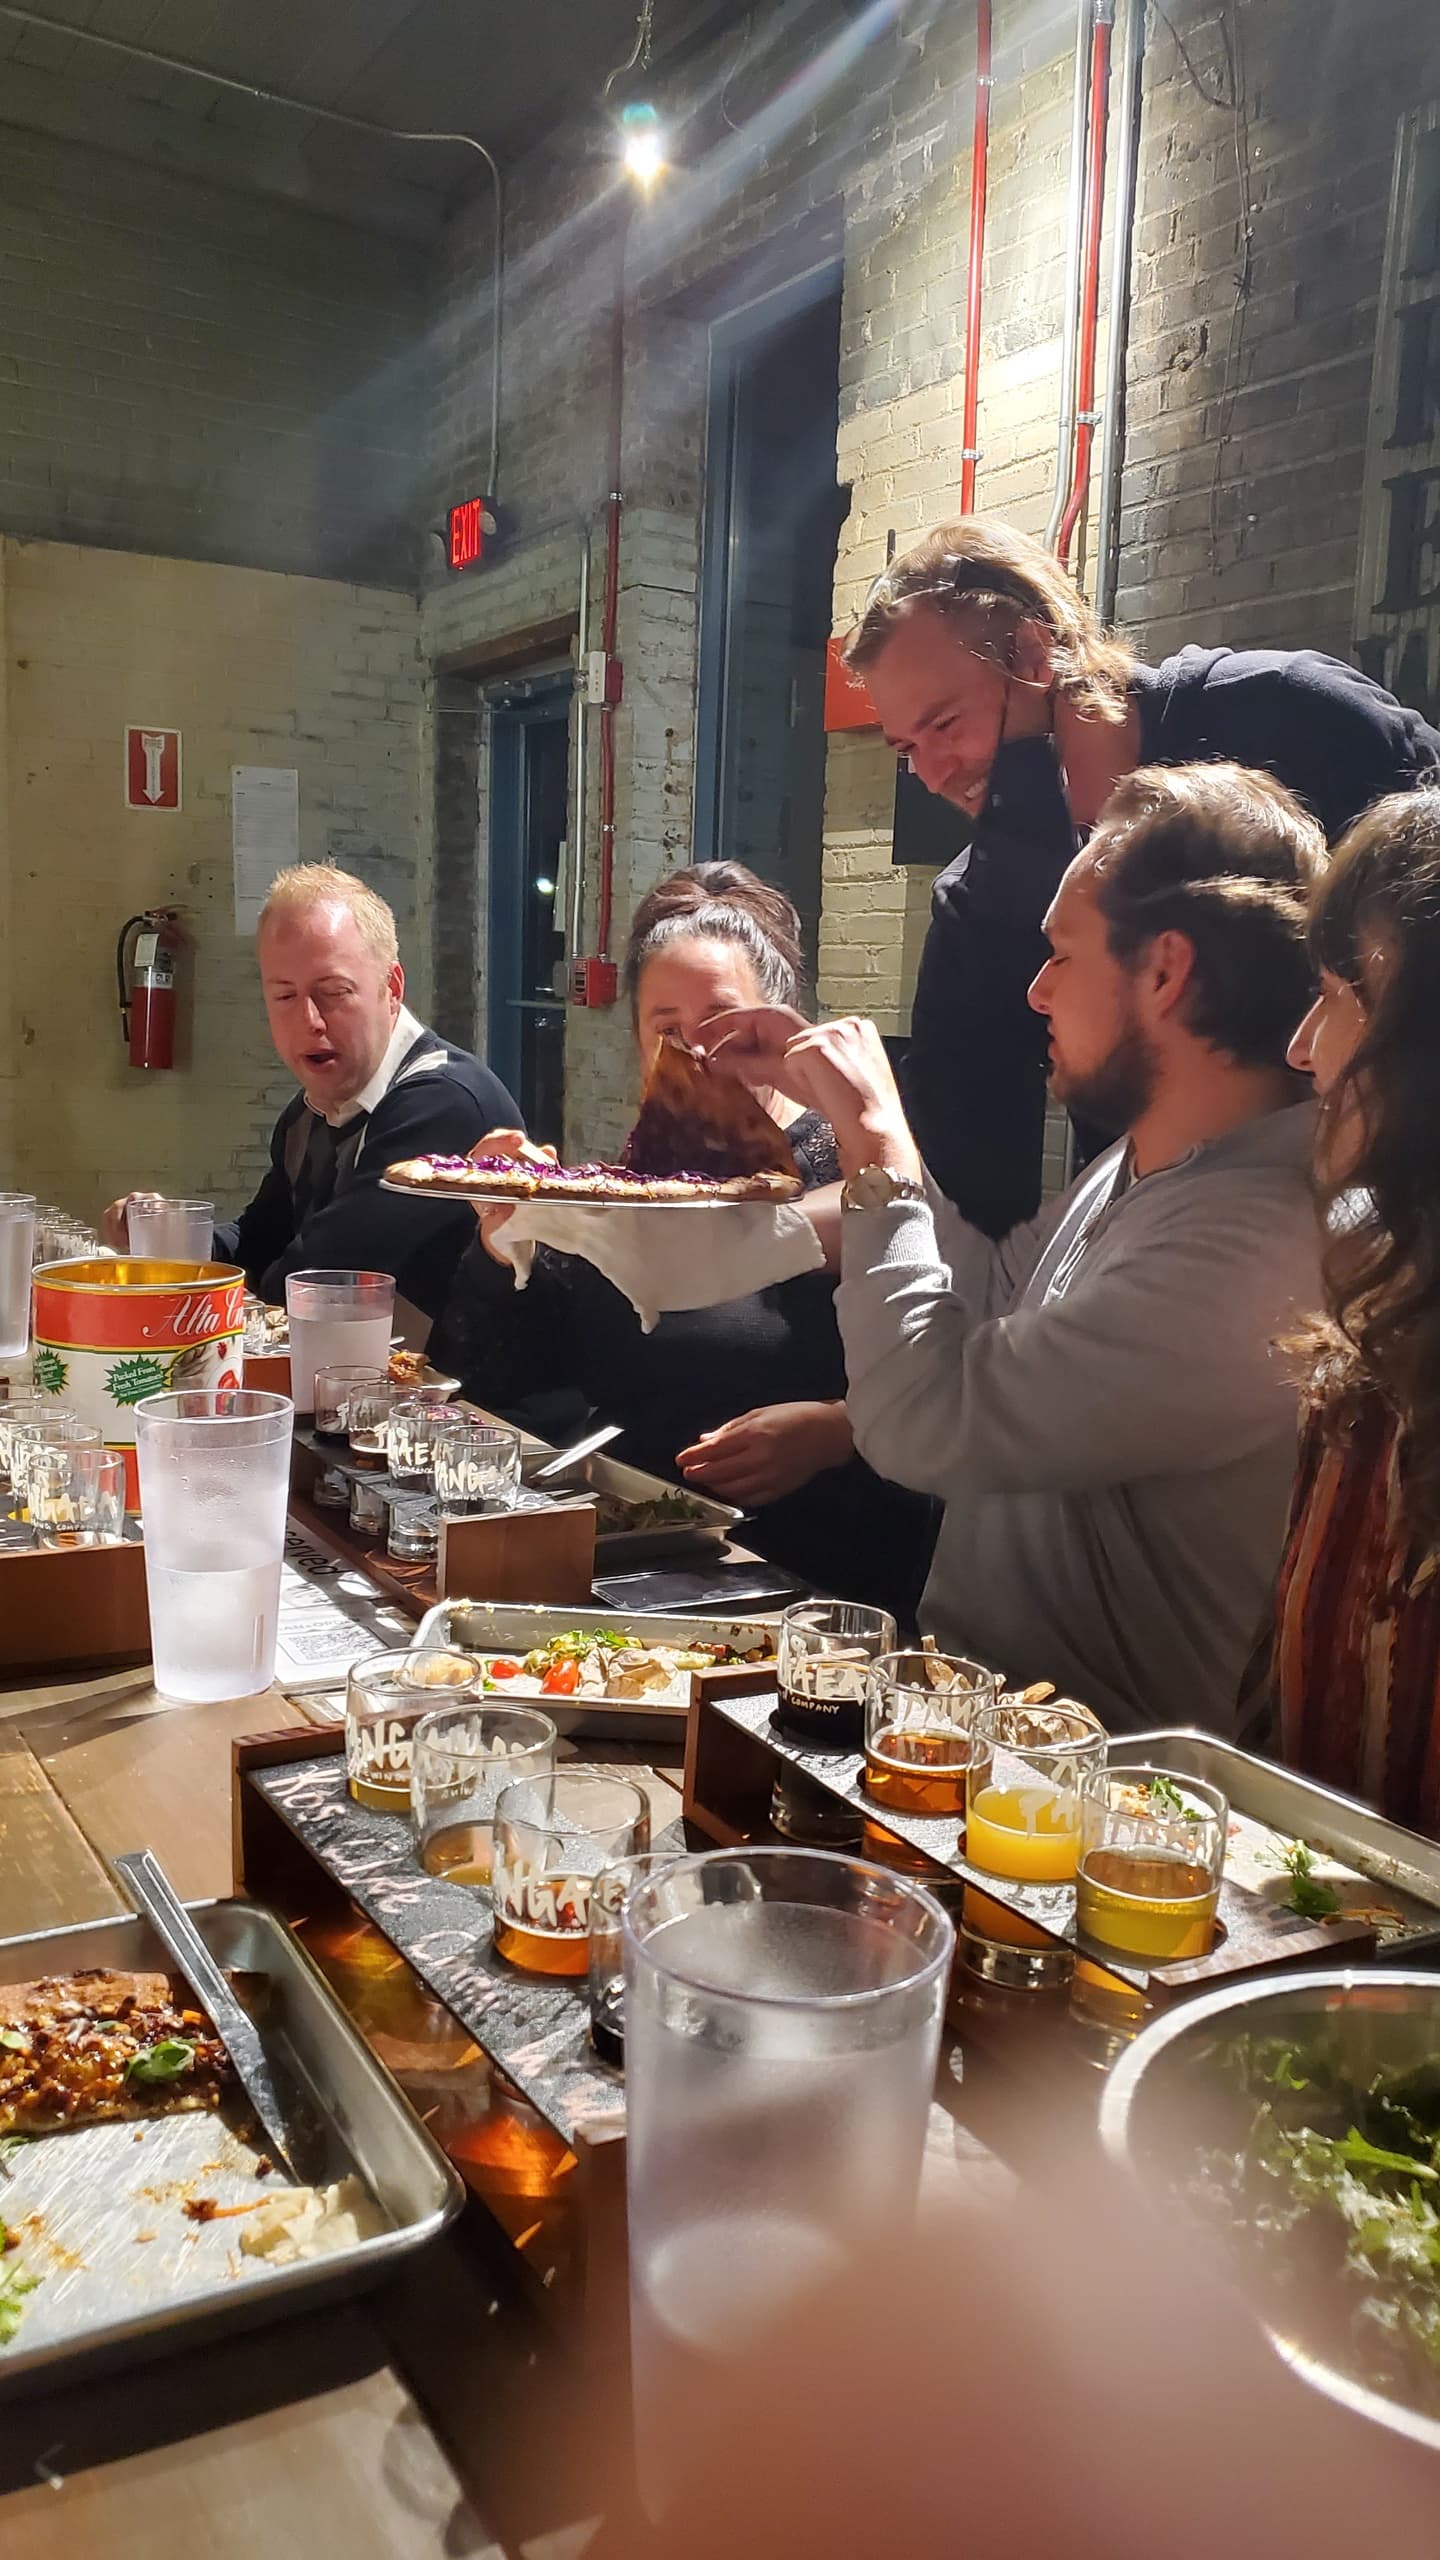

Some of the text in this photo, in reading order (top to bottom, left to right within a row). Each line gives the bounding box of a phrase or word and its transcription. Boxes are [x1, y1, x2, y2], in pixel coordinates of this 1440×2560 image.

[452, 499, 480, 564] EXIT
[142, 1295, 220, 1338] Alta
[791, 1696, 840, 1715] COMPANY
